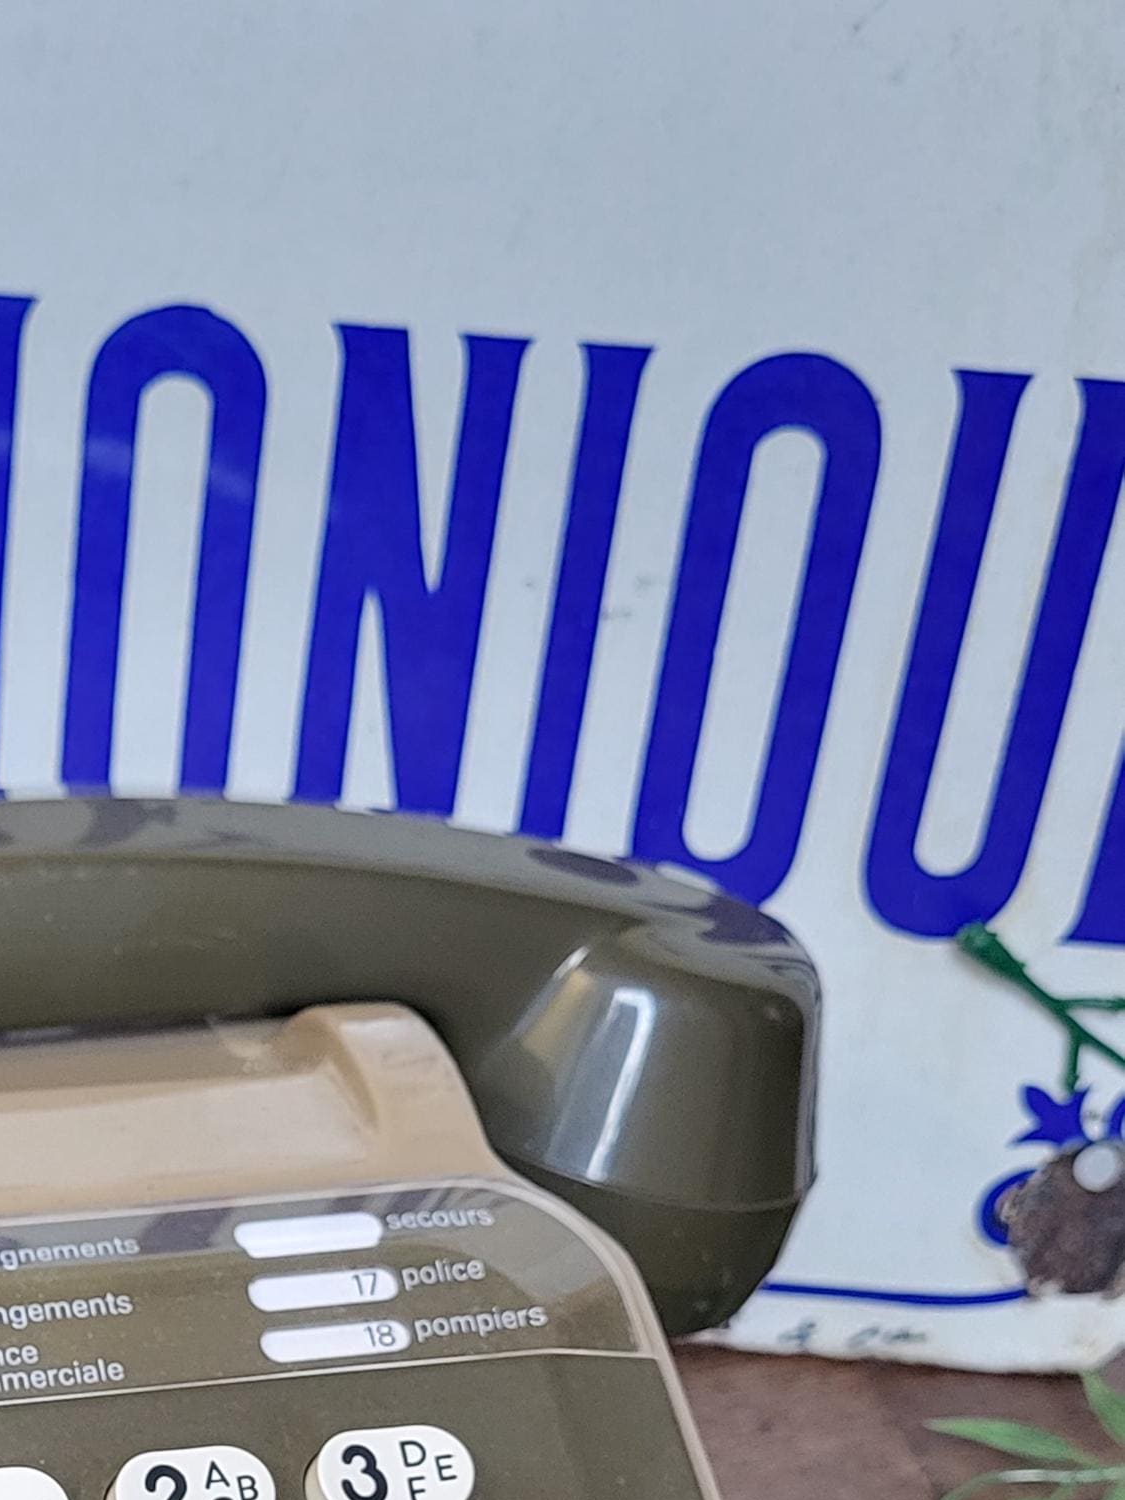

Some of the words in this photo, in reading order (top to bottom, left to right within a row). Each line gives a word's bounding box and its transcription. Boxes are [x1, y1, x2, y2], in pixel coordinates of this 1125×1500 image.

[385, 1207, 495, 1231] secours
[350, 1270, 379, 1297] 17
[401, 1257, 487, 1292] police
[363, 1322, 397, 1349] 18
[413, 1304, 549, 1344] pompiers
